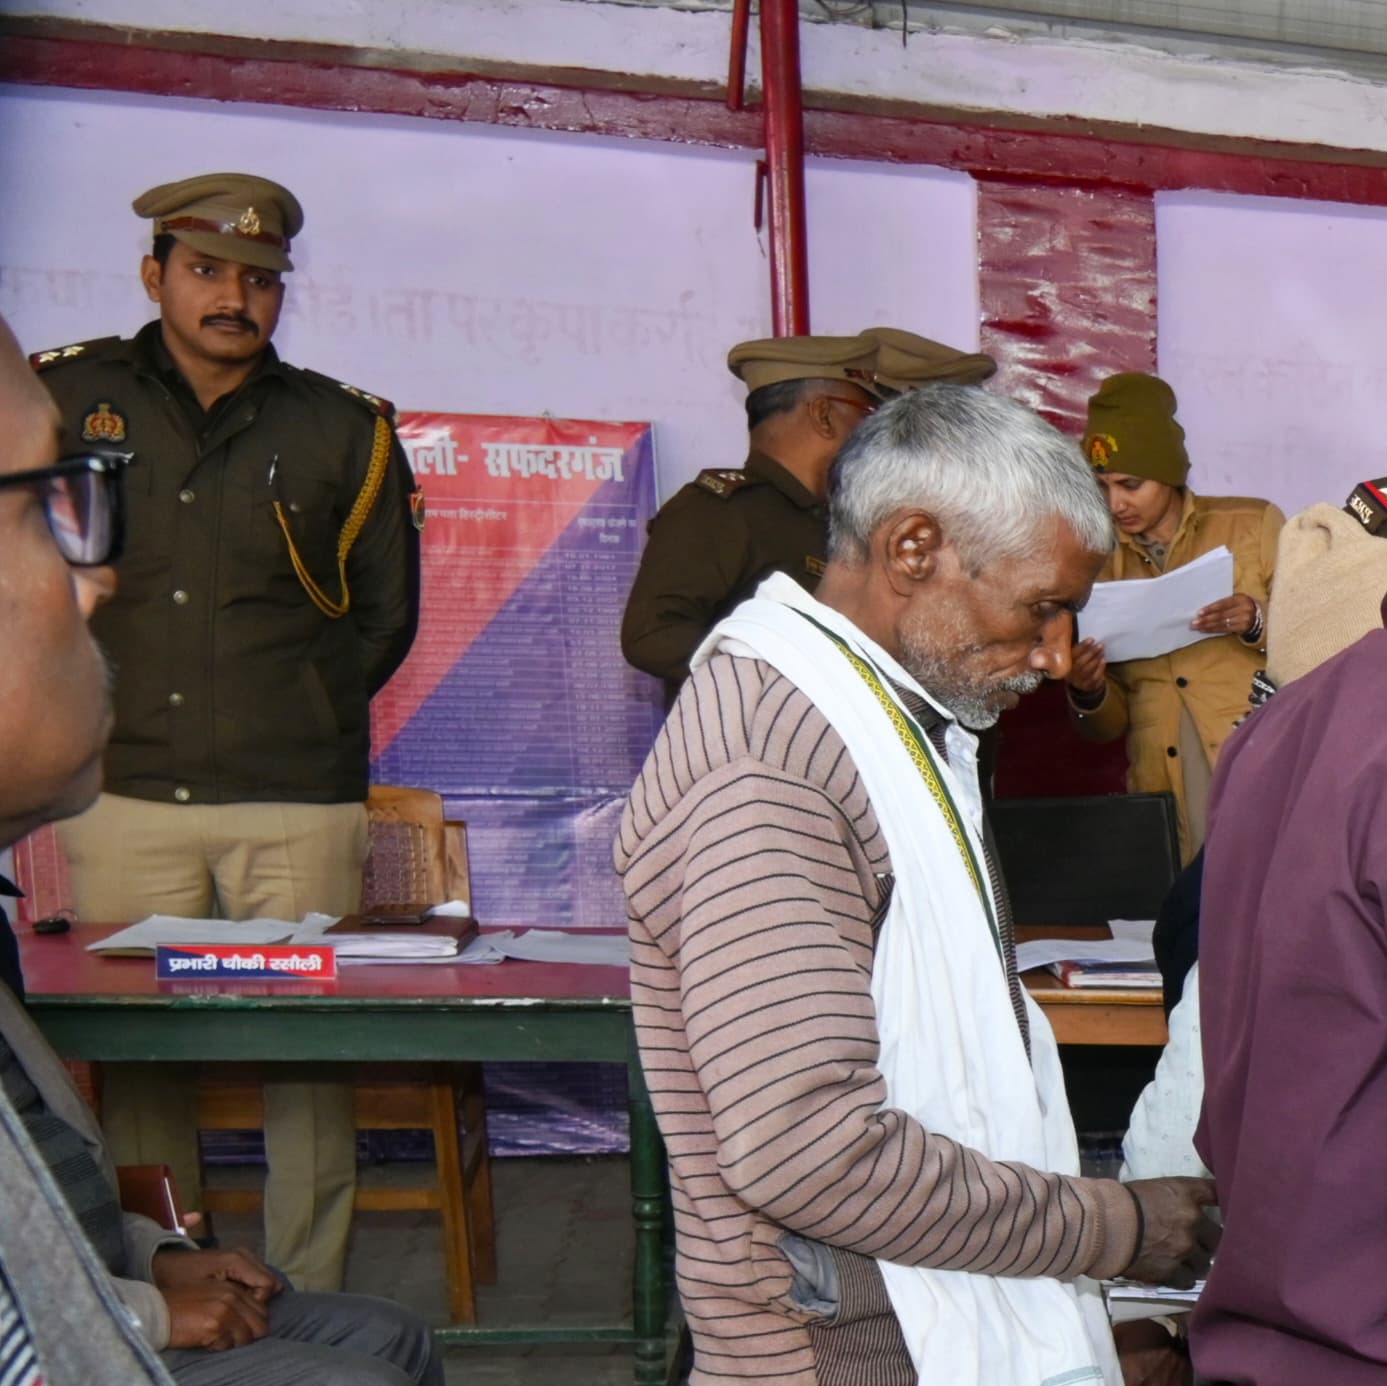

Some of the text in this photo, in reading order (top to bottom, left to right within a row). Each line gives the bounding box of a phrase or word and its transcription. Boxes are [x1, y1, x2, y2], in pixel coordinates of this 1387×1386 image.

[481, 435, 625, 482] सफदरगंज
[168, 953, 322, 972] प्रभारी चौकी रसौली
